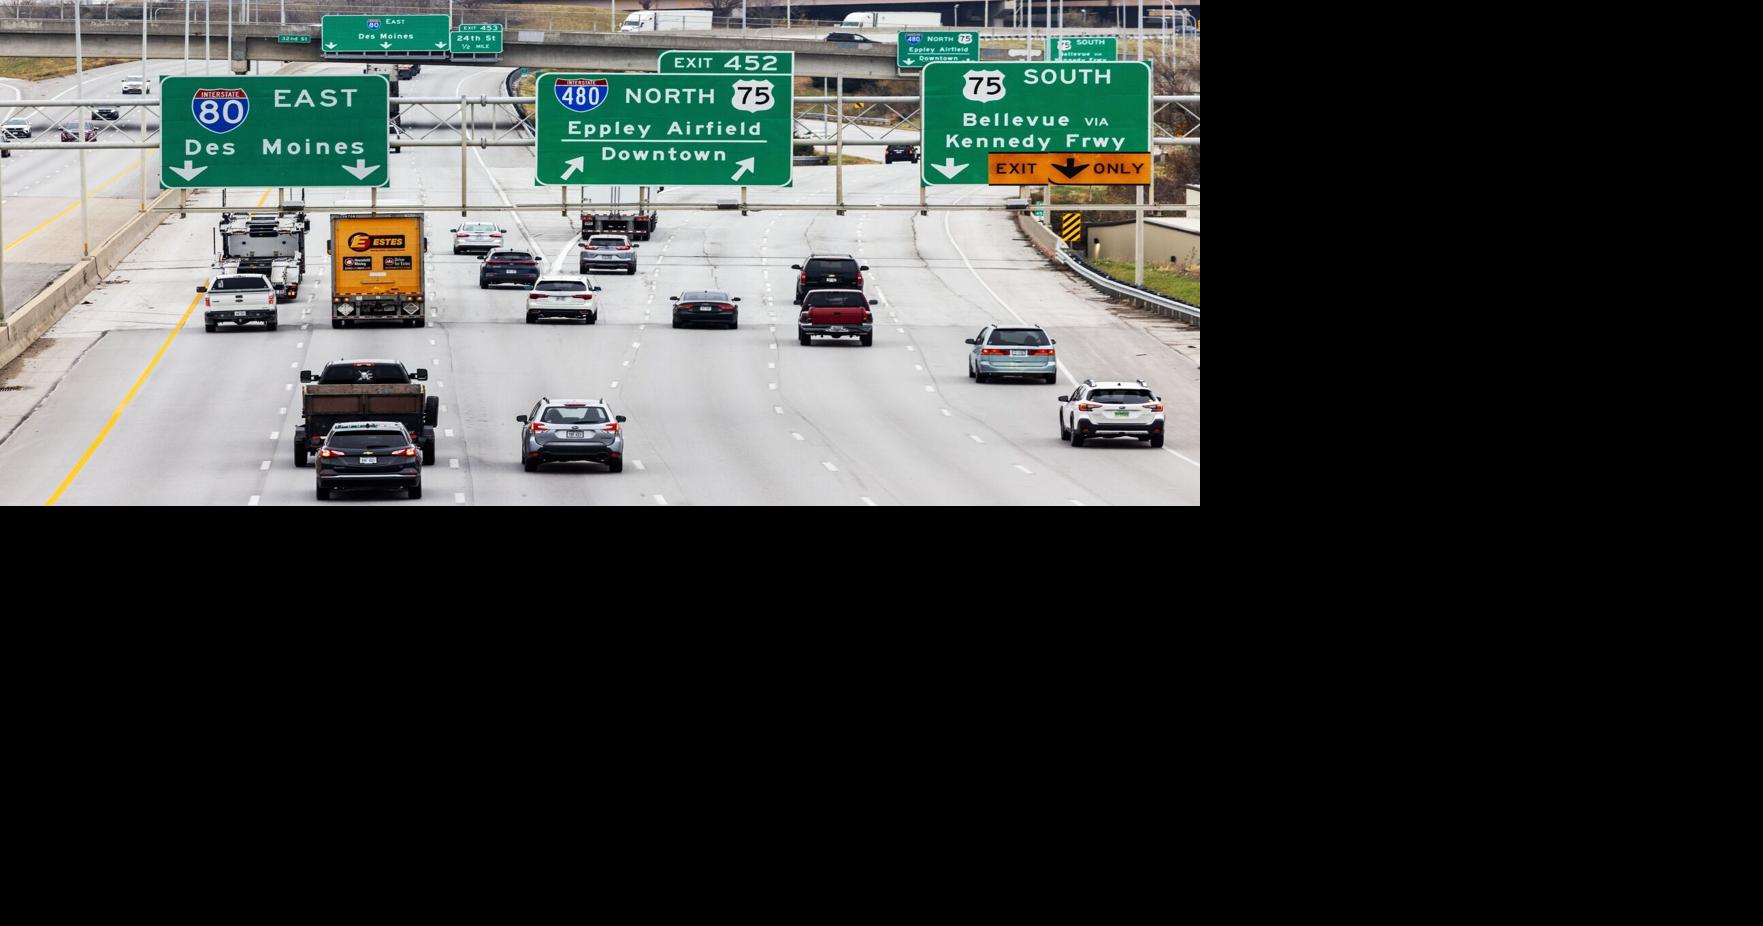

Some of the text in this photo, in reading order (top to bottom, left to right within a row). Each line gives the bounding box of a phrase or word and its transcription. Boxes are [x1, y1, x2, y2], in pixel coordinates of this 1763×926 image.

[908, 46, 936, 54] Eppley
[674, 55, 778, 71] EXIT 452
[1023, 68, 1111, 85] SOUTH
[968, 76, 1001, 95] 75
[274, 88, 358, 108] EAST
[561, 86, 600, 106] 480
[625, 87, 715, 104] NORTH
[737, 86, 770, 105] 75
[199, 99, 244, 125] 80
[962, 112, 1109, 127] Bellevue VIA
[568, 120, 761, 138] Eppley Airfield
[185, 138, 365, 156] Des Moines
[946, 133, 1126, 151] Kennedy Frwy
[601, 146, 726, 161] Downtown
[996, 162, 1144, 174] EXIT ONLY
[373, 238, 403, 246] ESTES
